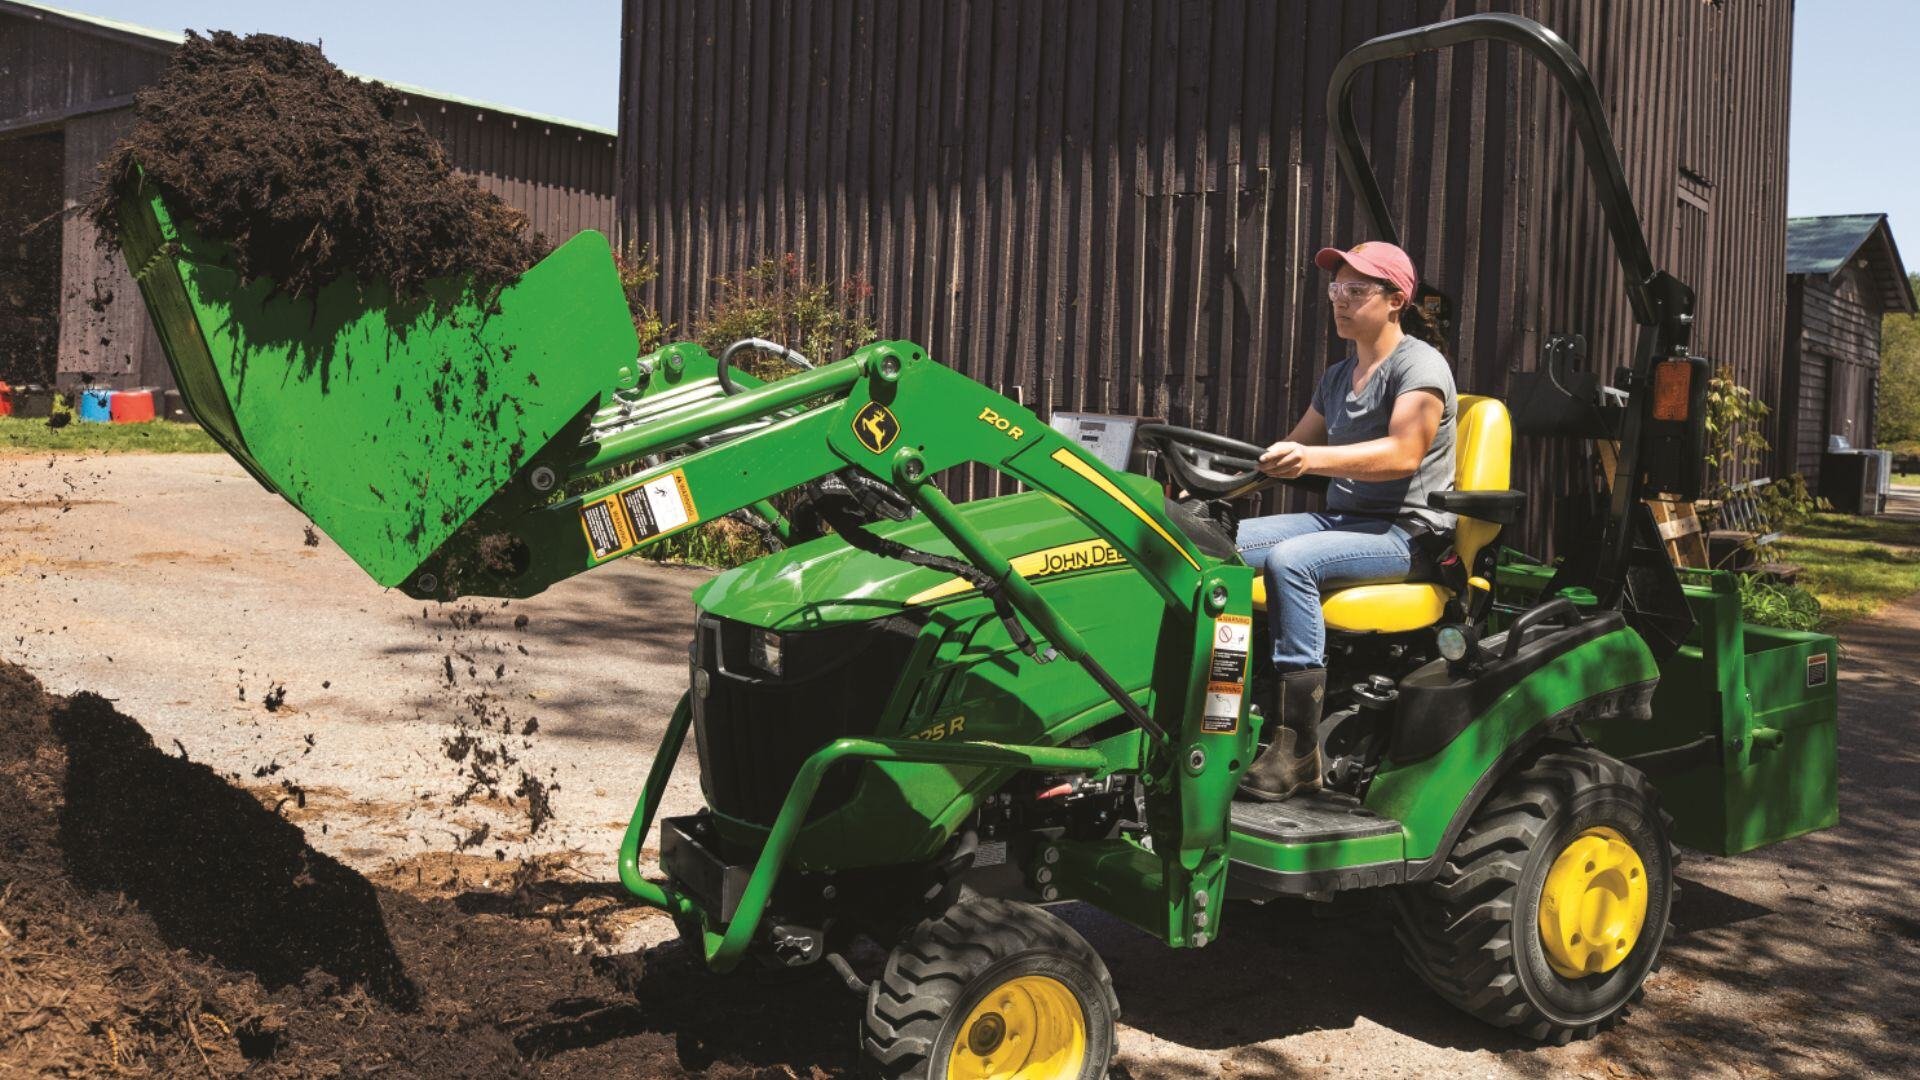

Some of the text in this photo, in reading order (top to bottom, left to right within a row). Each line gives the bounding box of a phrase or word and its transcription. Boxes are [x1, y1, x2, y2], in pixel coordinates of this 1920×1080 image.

[978, 406, 1024, 441] 120 R
[1039, 551, 1089, 573] JOHN
[949, 715, 966, 736] R
